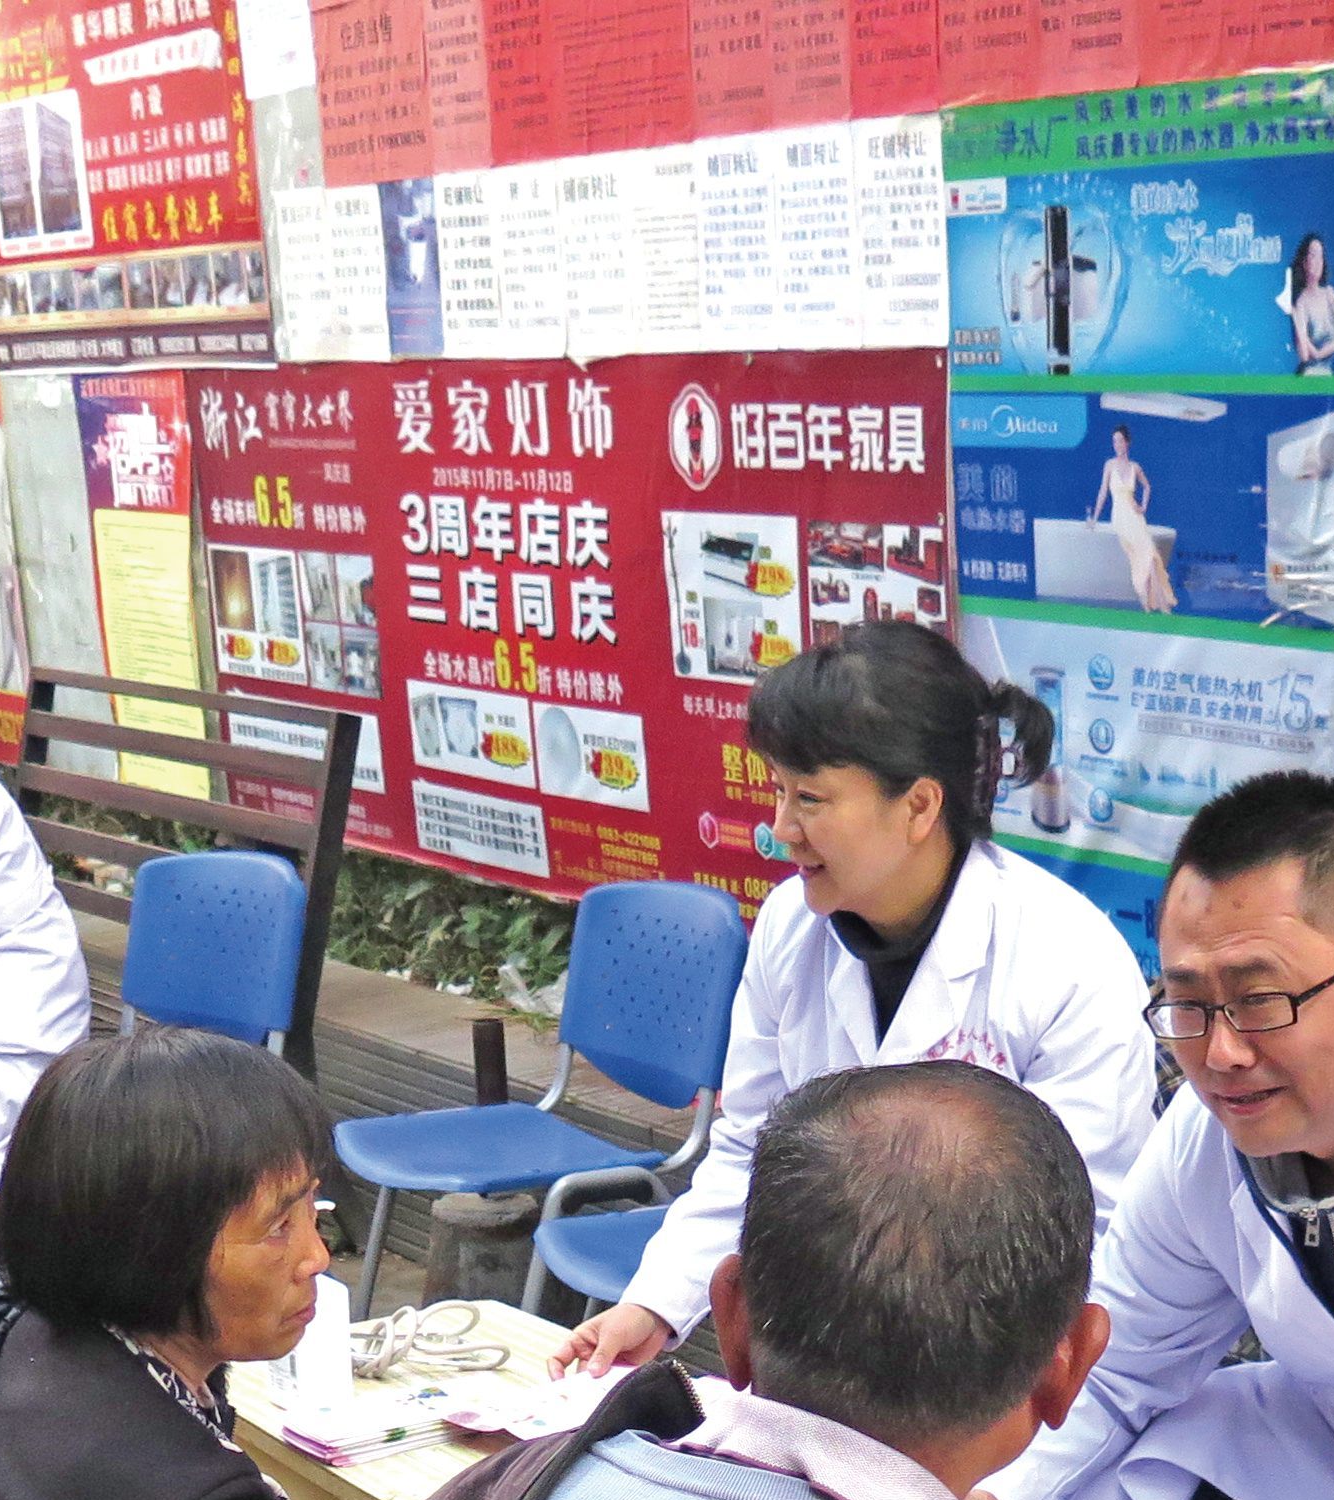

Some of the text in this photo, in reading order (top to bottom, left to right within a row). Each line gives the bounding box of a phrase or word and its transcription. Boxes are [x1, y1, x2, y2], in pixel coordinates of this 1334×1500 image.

[393, 377, 614, 459] 爱家灯饰
[730, 402, 926, 474] 好百年家具
[399, 492, 611, 570] 3周年店庆
[405, 564, 617, 645] 三店同庆
[1132, 667, 1263, 702] 美的空气能热水机
